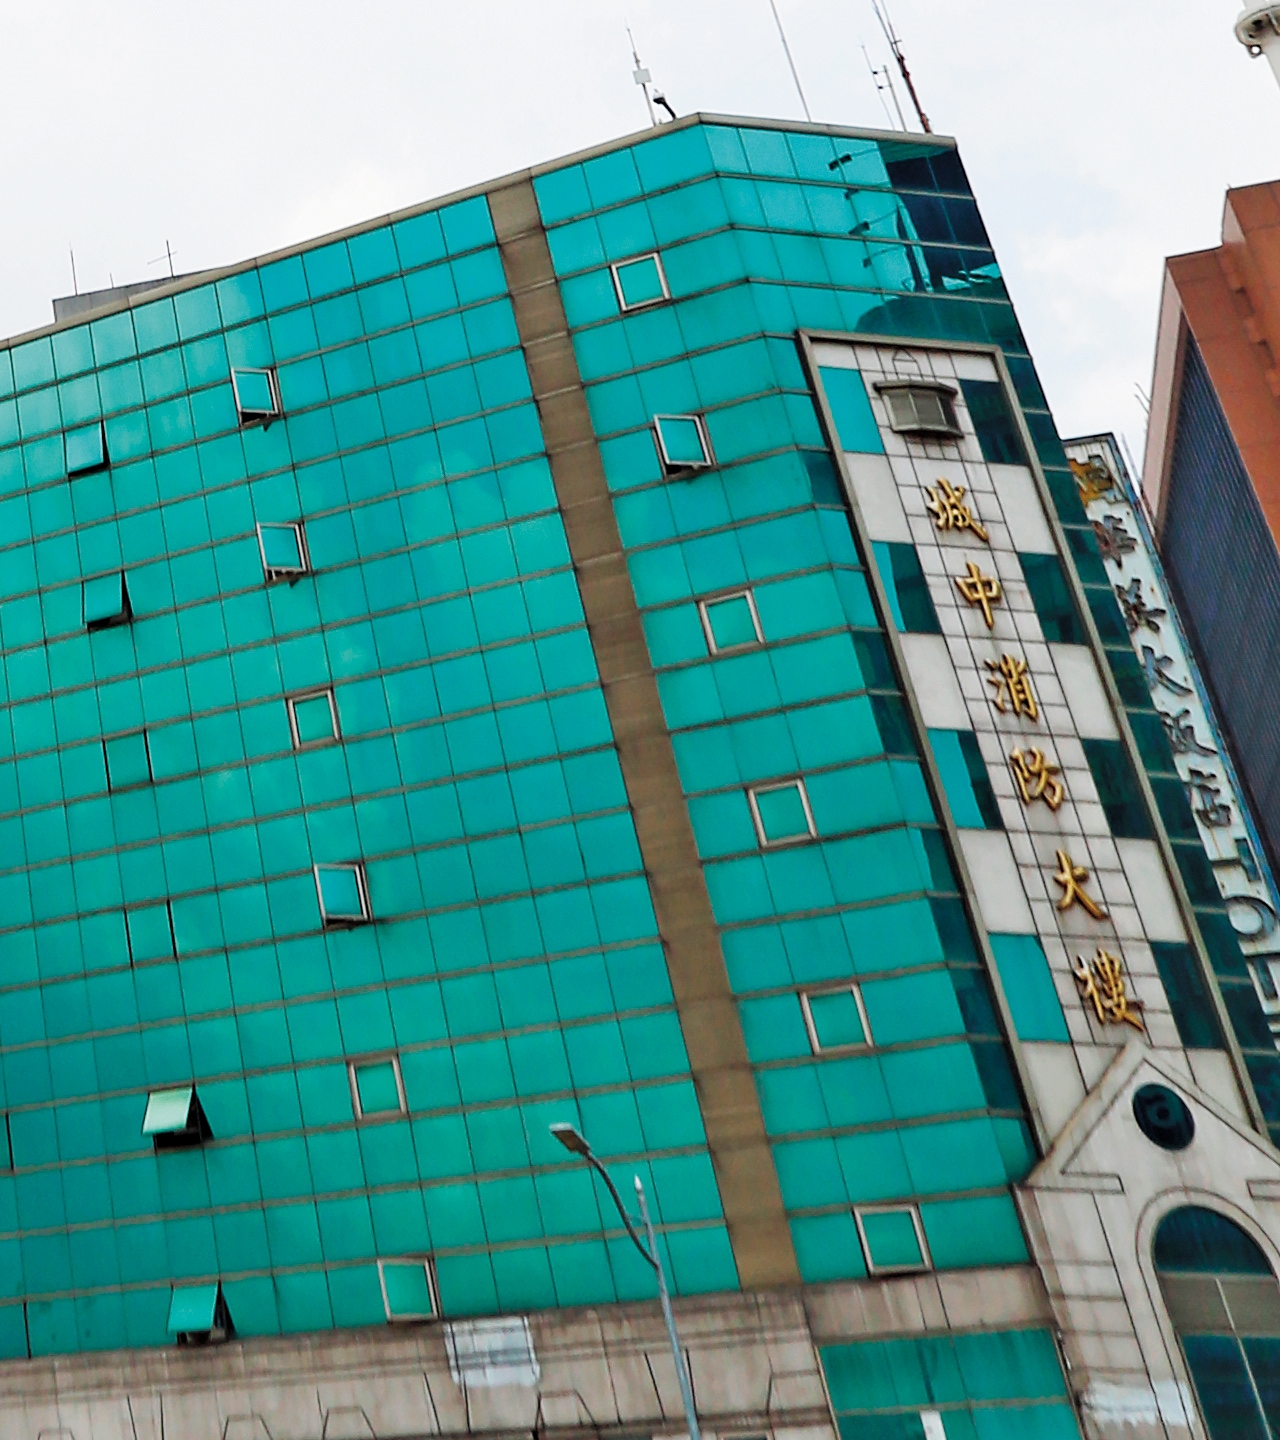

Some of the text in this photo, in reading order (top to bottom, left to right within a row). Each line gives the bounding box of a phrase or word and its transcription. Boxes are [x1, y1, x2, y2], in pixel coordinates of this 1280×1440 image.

[926, 477, 1146, 1034] 城中消防大樓
